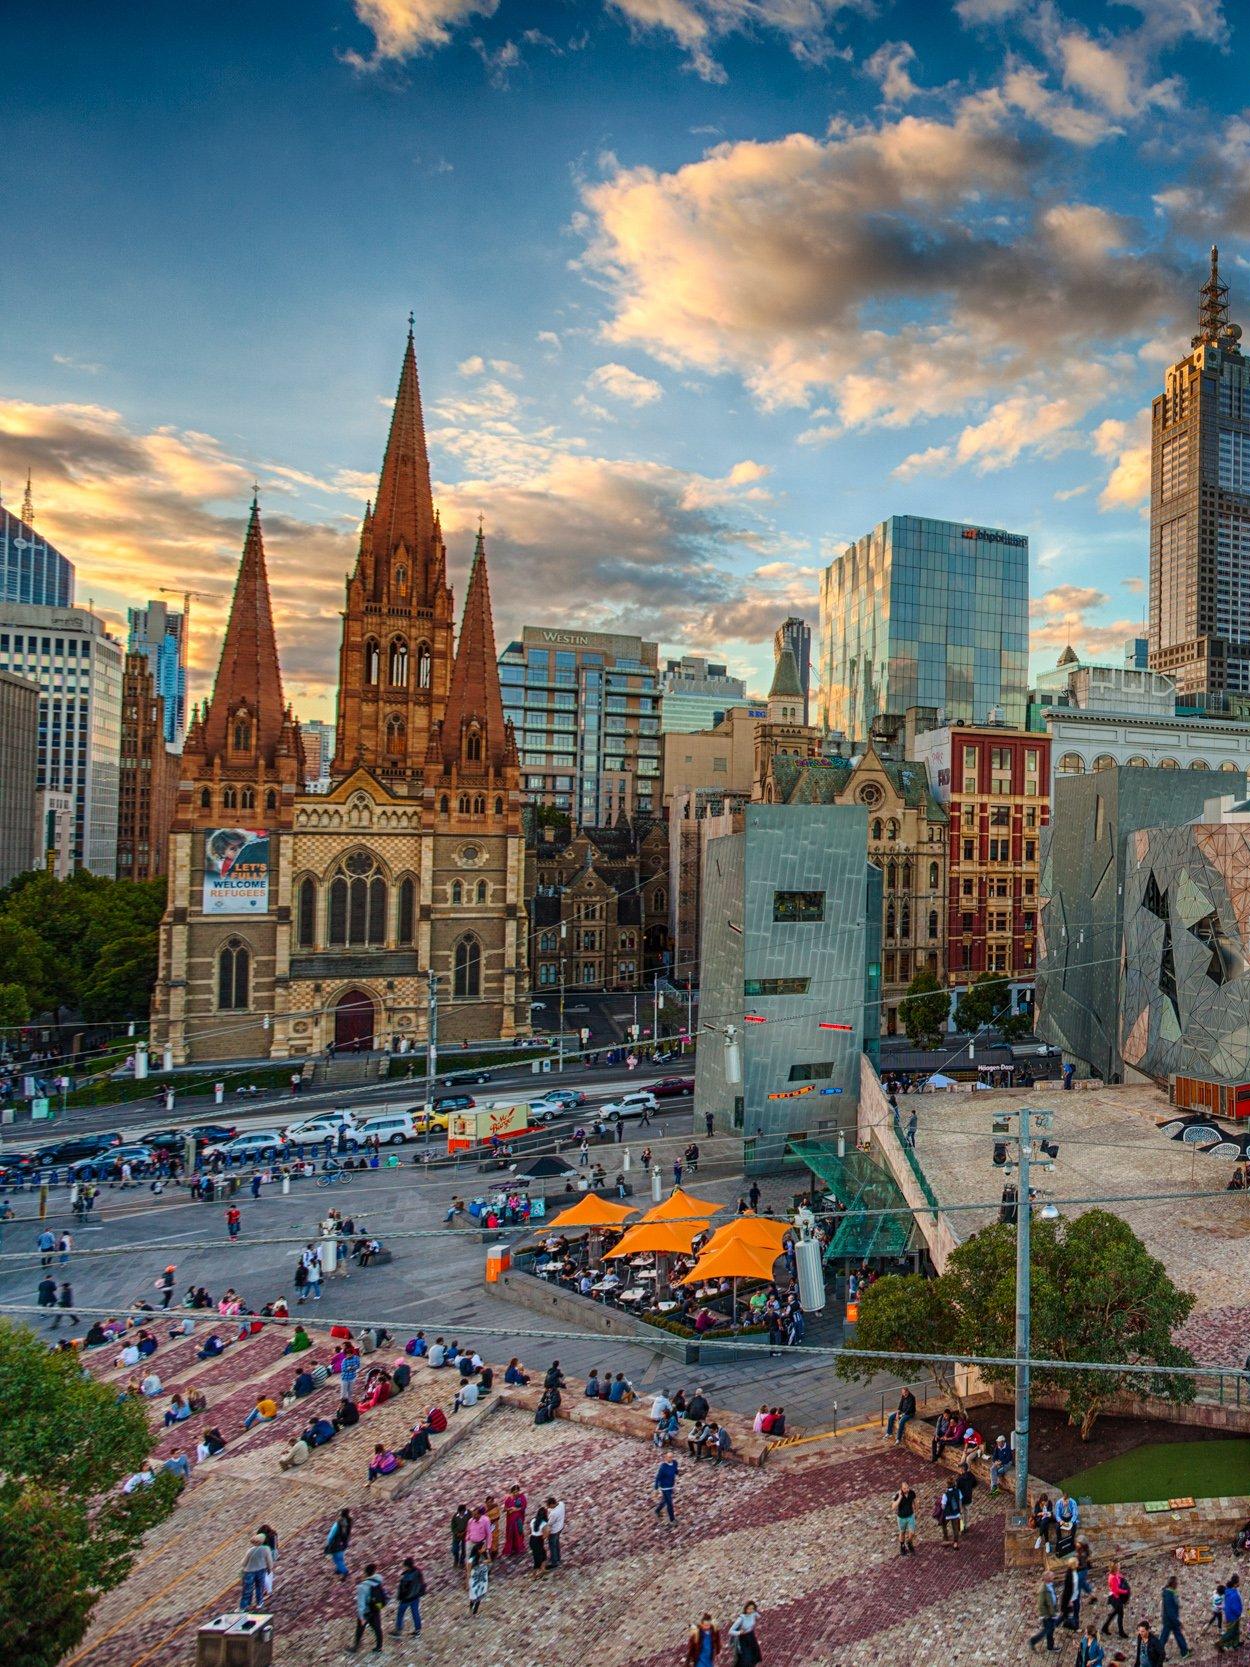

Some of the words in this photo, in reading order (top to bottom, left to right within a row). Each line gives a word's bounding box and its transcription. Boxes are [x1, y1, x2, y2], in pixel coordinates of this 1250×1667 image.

[543, 631, 588, 645] WESTIN
[235, 863, 267, 871] LET'S
[231, 872, 267, 880] FULLY
[210, 889, 266, 897] REFUGEES
